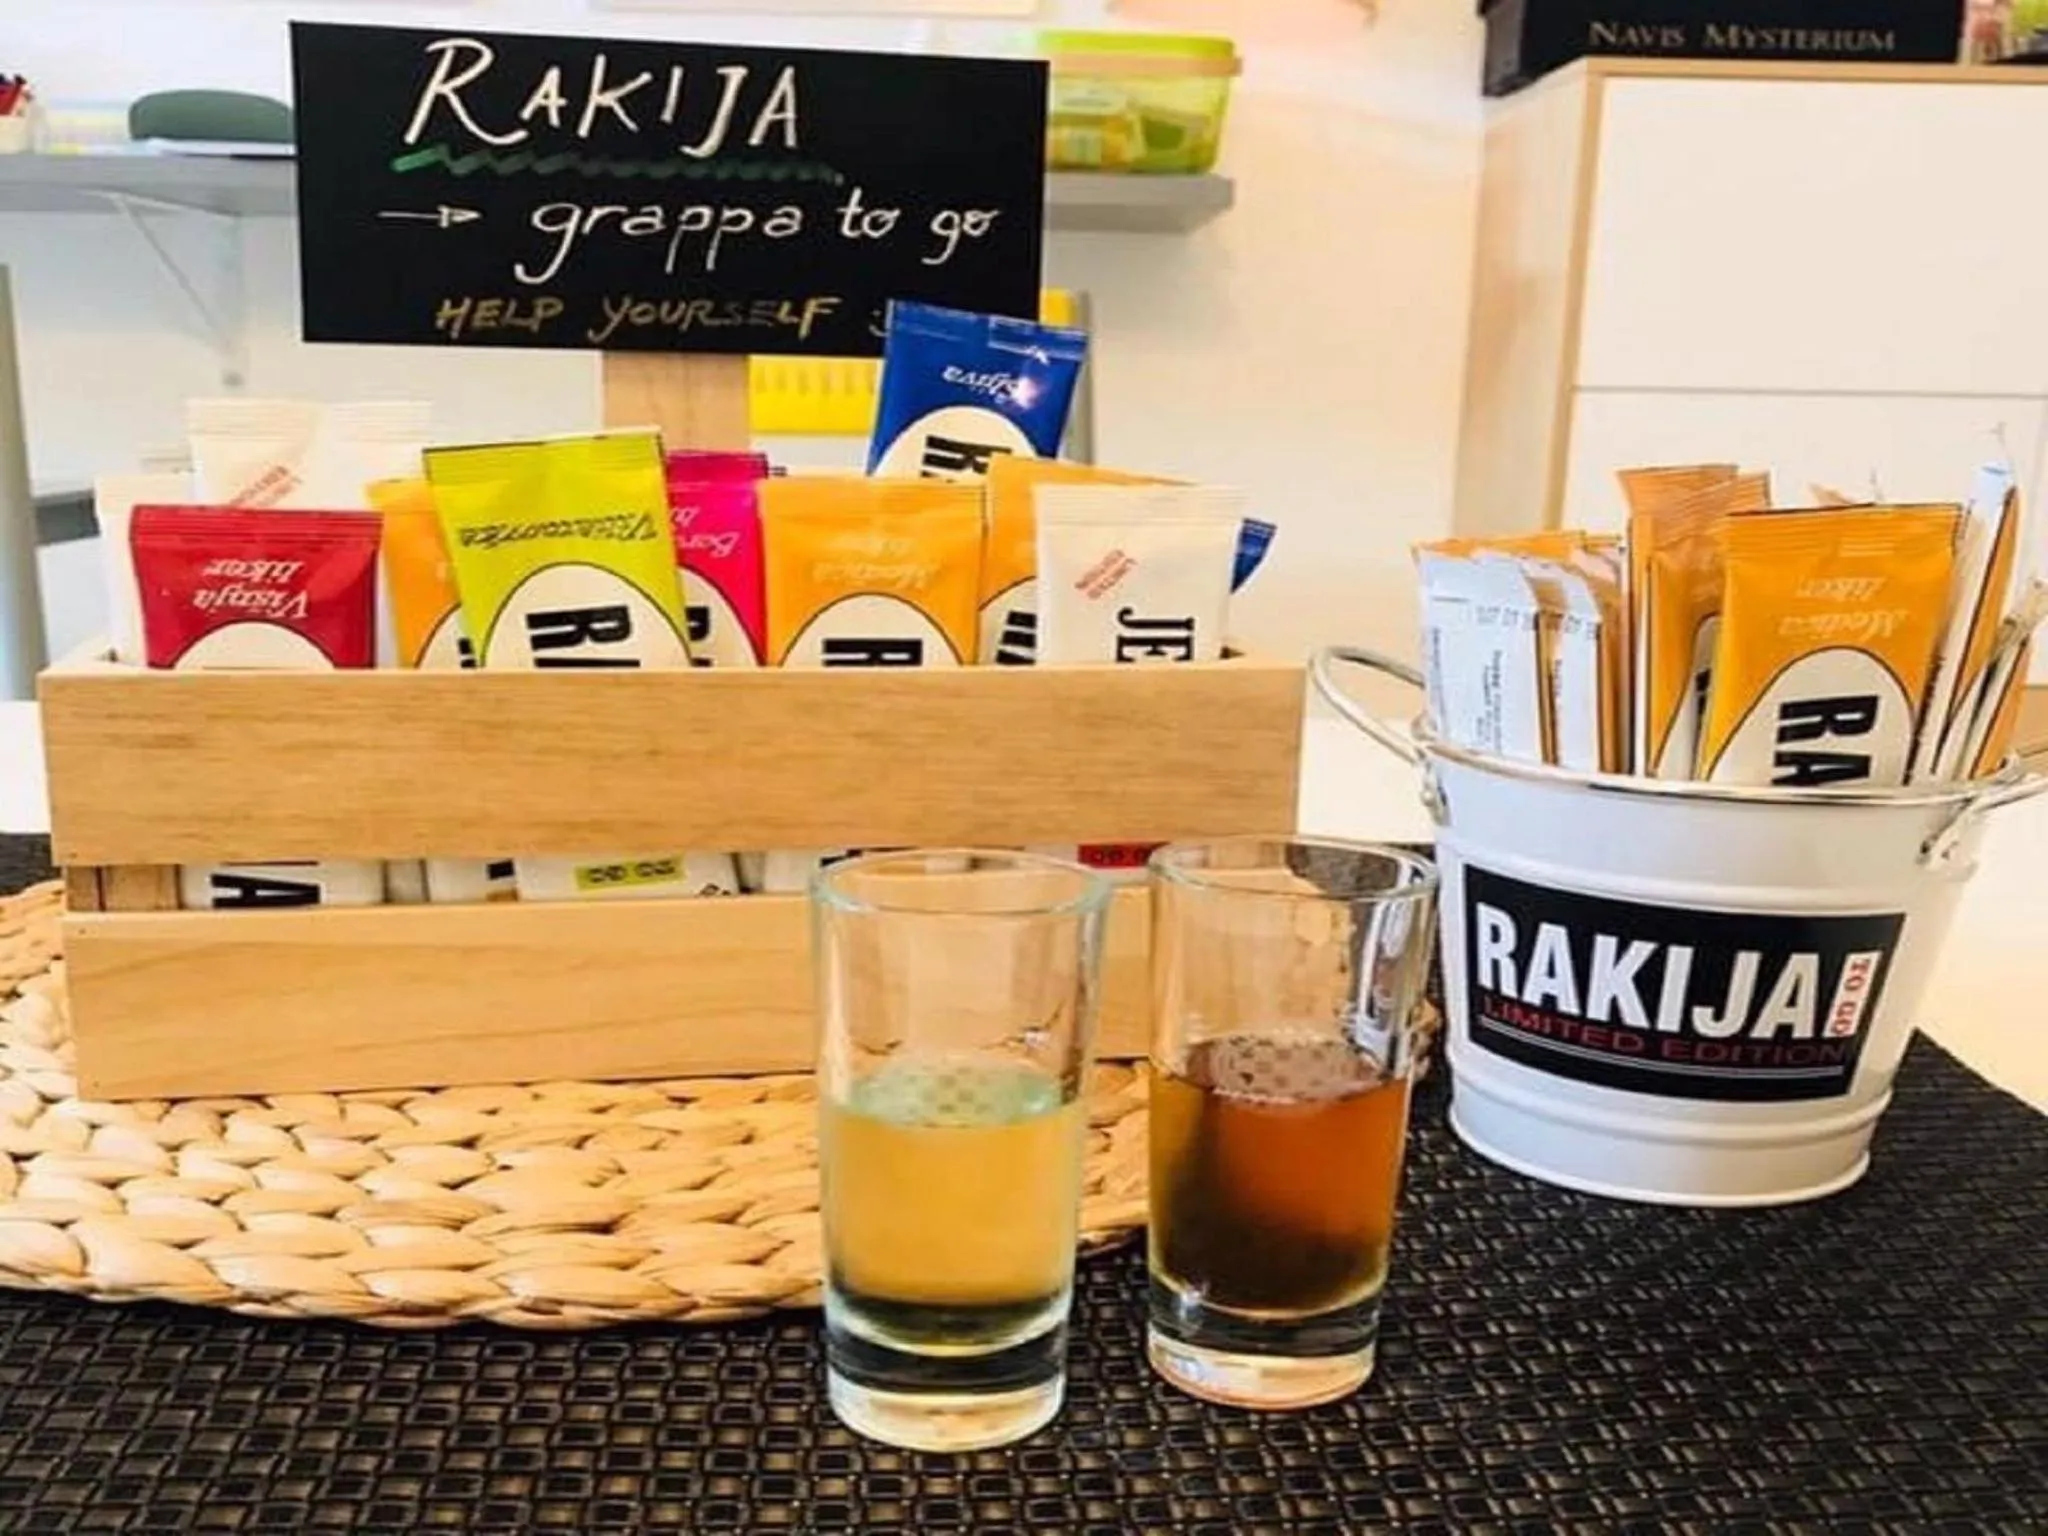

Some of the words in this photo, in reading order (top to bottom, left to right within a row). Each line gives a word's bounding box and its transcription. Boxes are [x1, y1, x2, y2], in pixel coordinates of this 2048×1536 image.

[514, 197, 804, 284] grappa
[837, 187, 901, 239] to
[921, 207, 999, 265] go
[435, 297, 564, 332] HELP
[1476, 902, 1820, 1039] RAKIJA
[1483, 996, 1645, 1053] LIMITED
[1662, 1036, 1847, 1067] EDITION
